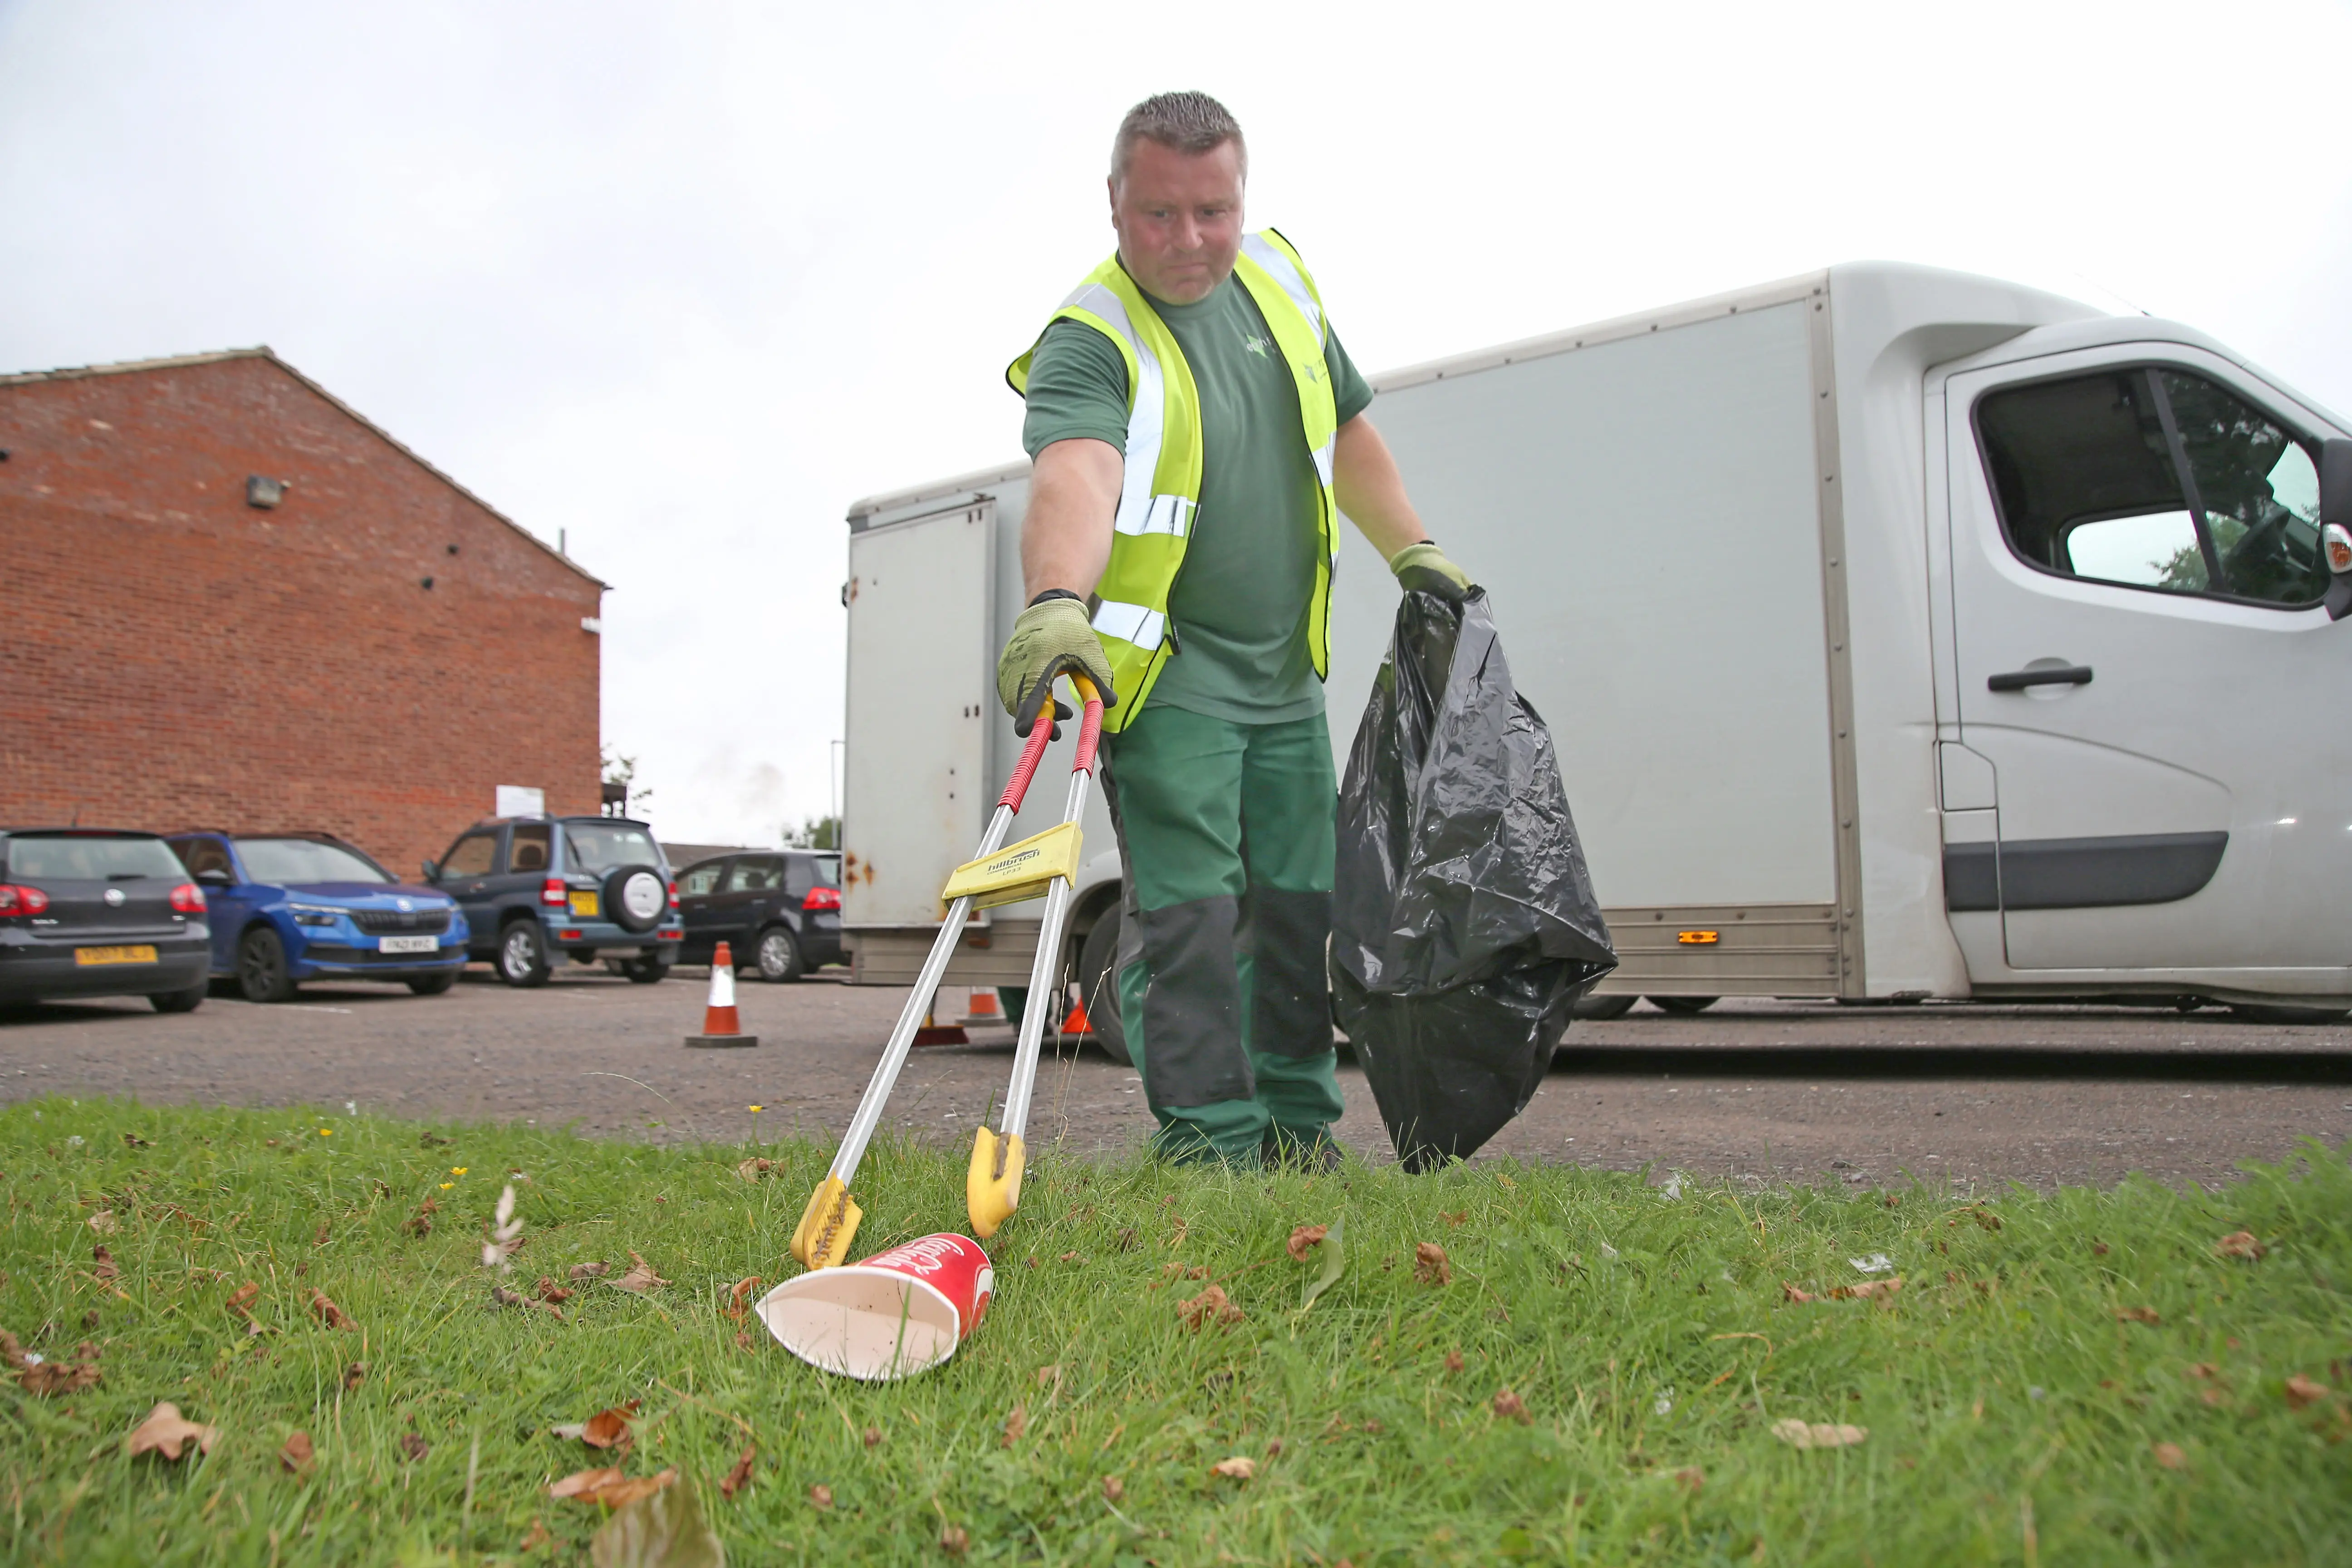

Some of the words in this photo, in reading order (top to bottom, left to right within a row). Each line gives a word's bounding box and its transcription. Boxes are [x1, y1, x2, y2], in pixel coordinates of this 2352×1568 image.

[988, 848, 1040, 872] hillbrush
[987, 862, 1022, 875] COMMERCIAL
[1003, 867, 1021, 876] LP33
